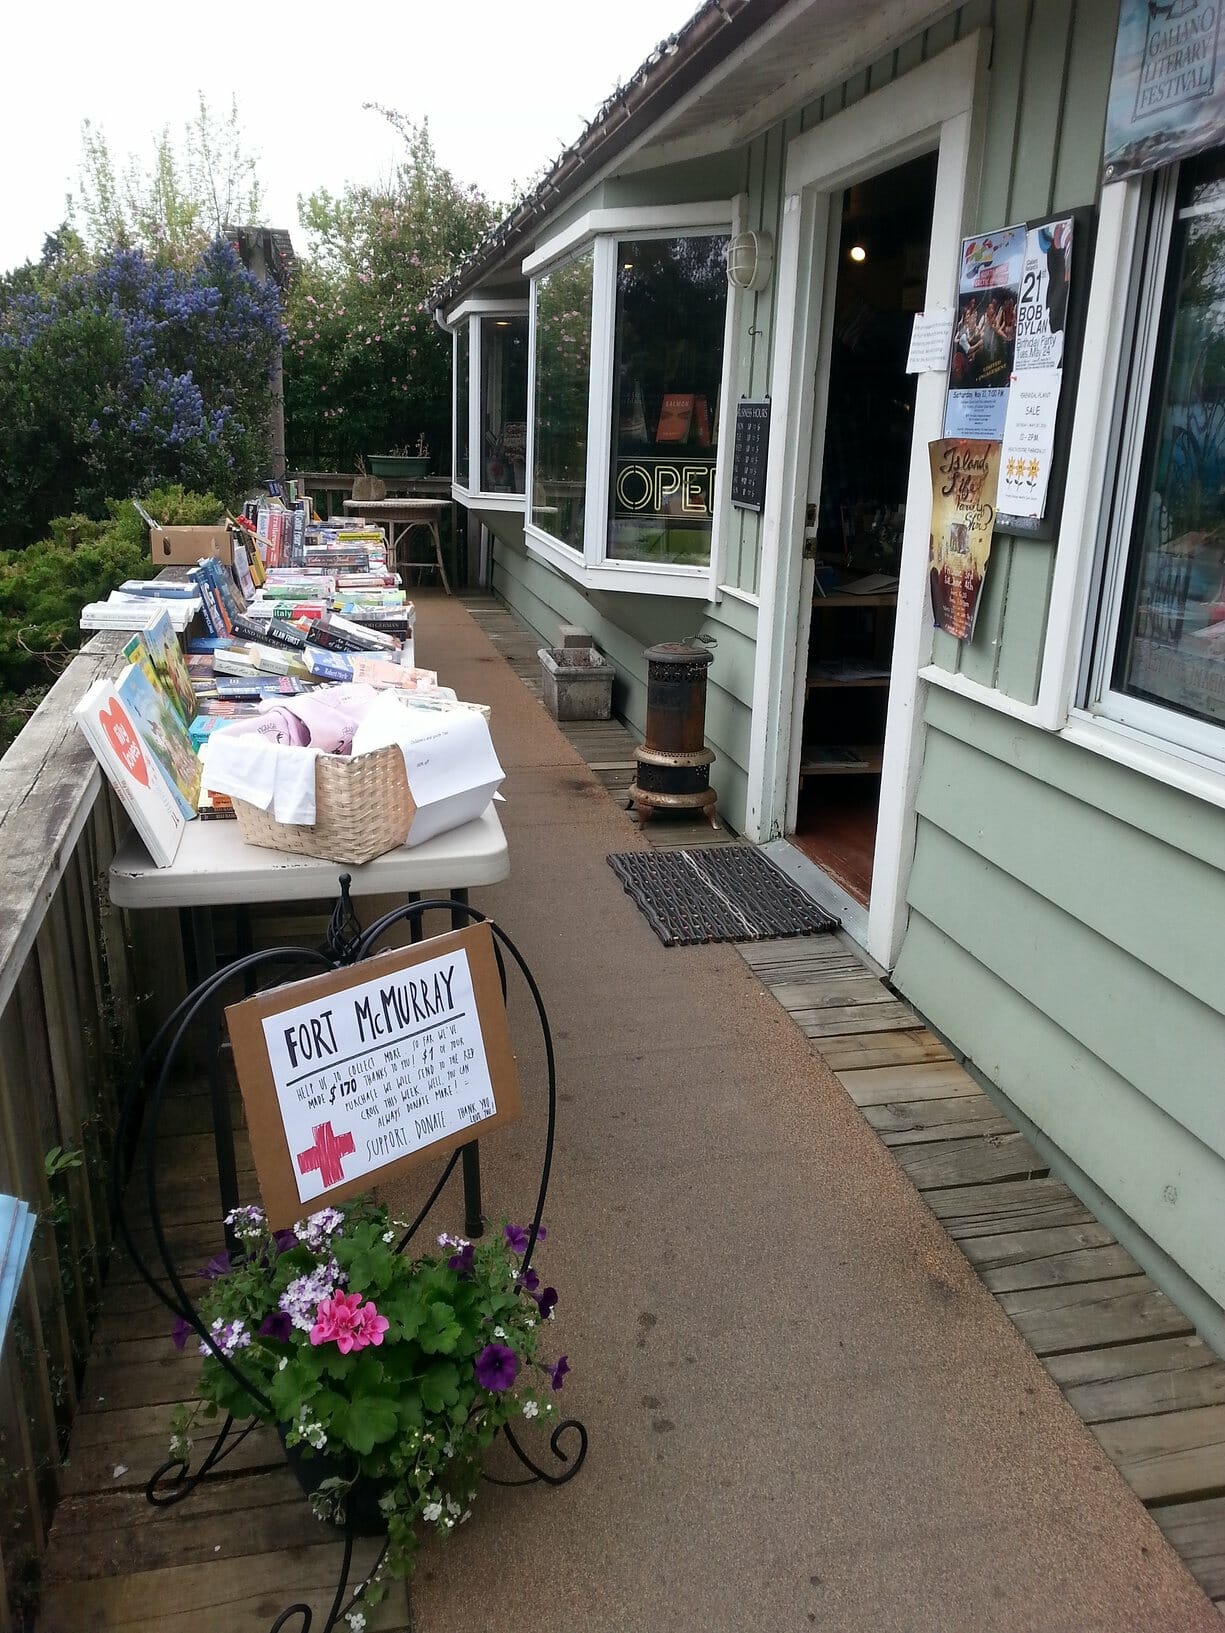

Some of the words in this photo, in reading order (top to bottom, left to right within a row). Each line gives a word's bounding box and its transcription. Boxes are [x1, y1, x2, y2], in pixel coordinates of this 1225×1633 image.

[1149, 6, 1216, 57] GALIANO
[1144, 39, 1209, 84] LITERARY
[1139, 66, 1208, 109] FESTIVAL
[1017, 319, 1049, 337] DYLAN
[1018, 304, 1043, 322] BOB
[1025, 405, 1041, 416] SALE
[940, 444, 992, 473] Island
[941, 471, 983, 500] Life
[242, 629, 256, 638] AND
[272, 629, 286, 641] ALAN
[285, 634, 301, 646] FURST
[283, 1010, 338, 1068] FORT
[354, 965, 455, 1043] McMURRAY
[296, 1083, 314, 1101] HELP
[318, 1076, 327, 1090] US
[333, 1071, 342, 1083] TO
[348, 1057, 375, 1077] COLLECT
[412, 1040, 419, 1051] SO
[422, 1034, 434, 1046] FAR
[438, 1025, 457, 1039] WE'VE
[308, 1094, 326, 1109] MADE
[329, 1078, 357, 1105] $170
[363, 1067, 388, 1086] THANKS
[391, 1063, 398, 1073] TO
[422, 1046, 434, 1064] $1
[439, 1045, 446, 1054] OF
[450, 1037, 465, 1051] YOUR
[345, 1089, 378, 1112] PURCHASE
[383, 1081, 392, 1094] WE
[396, 1074, 411, 1089] WILL
[418, 1064, 434, 1080] SEND
[439, 1061, 445, 1070] TO
[449, 1053, 459, 1065] THE
[463, 1048, 474, 1061] RED
[360, 1104, 380, 1120] CROSS
[384, 1096, 397, 1108] THIS
[447, 1069, 456, 1080] YOU
[460, 1064, 470, 1075] CAN
[377, 1107, 401, 1128] ALWAYS
[406, 1095, 429, 1113] DONATE
[457, 1103, 476, 1120] THANK
